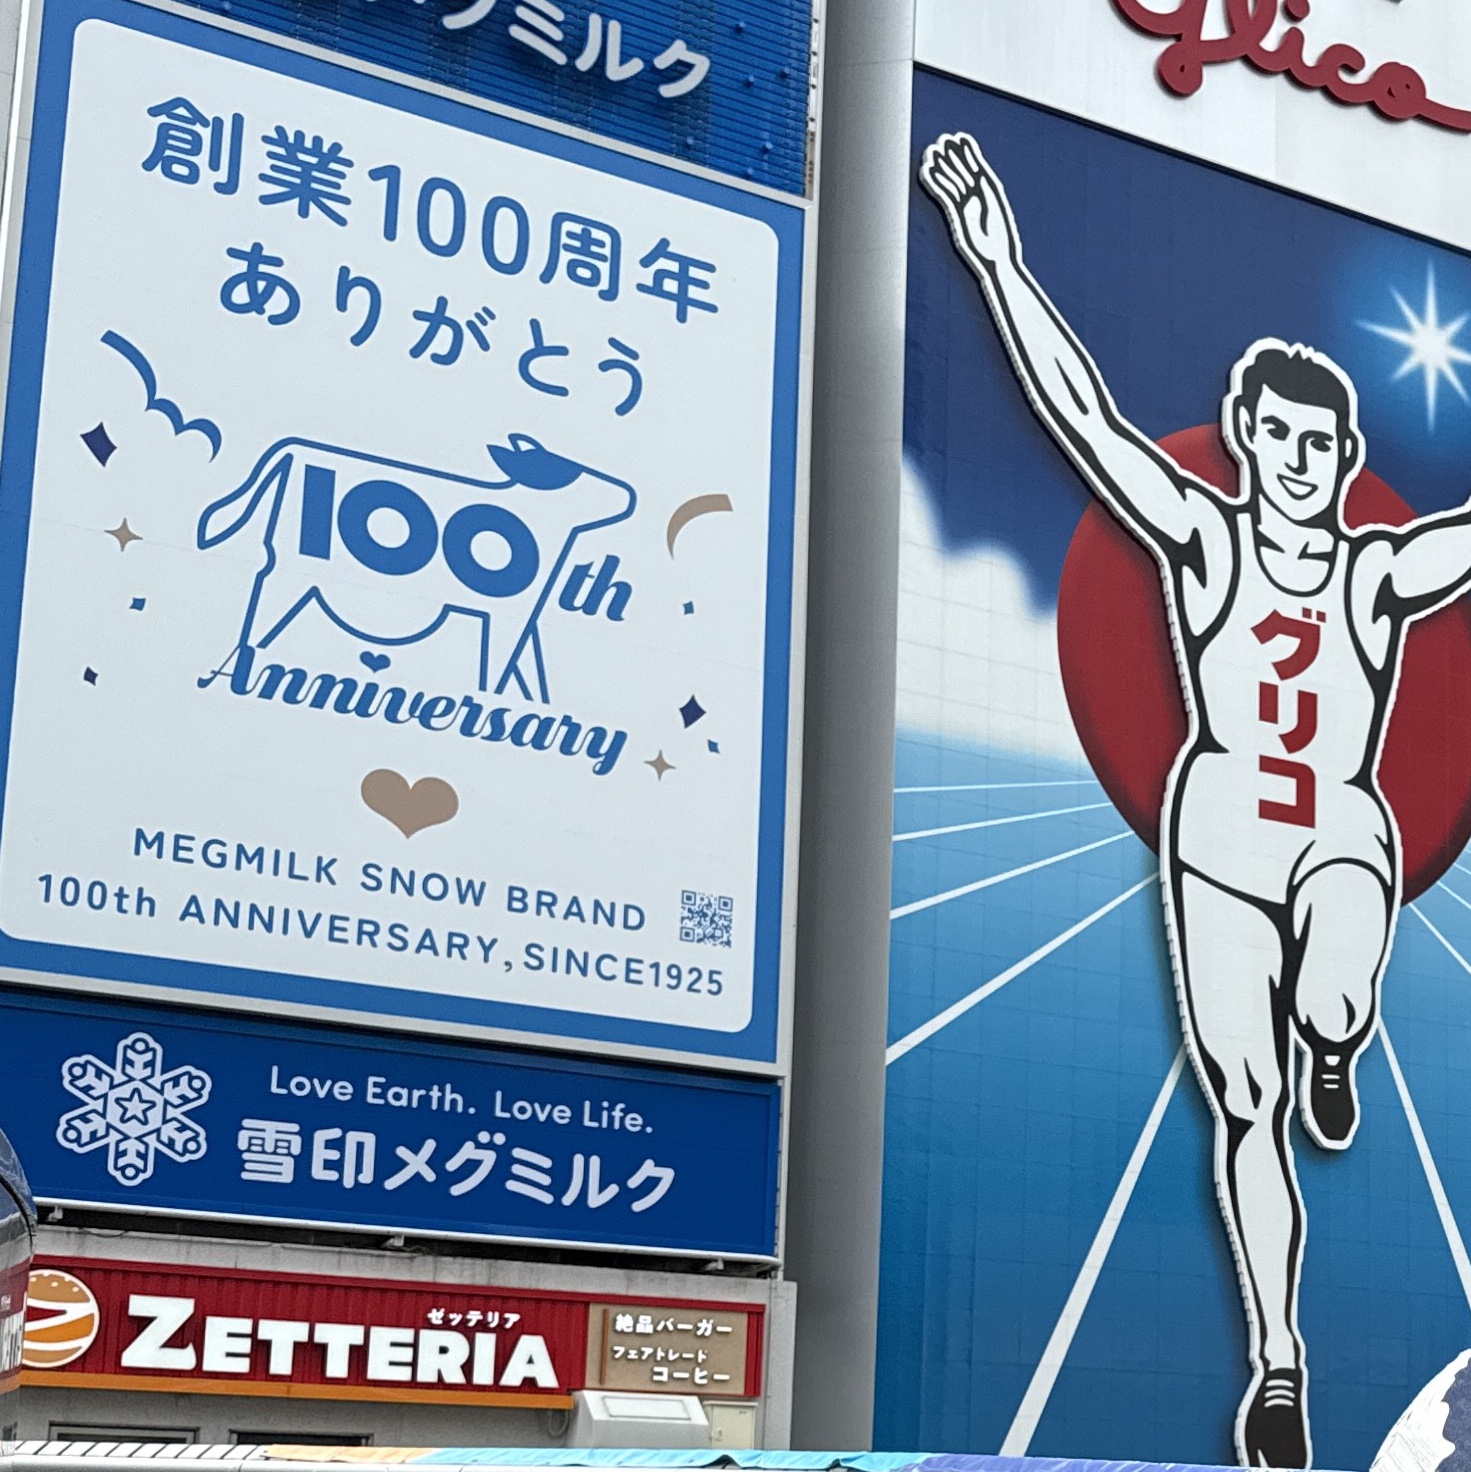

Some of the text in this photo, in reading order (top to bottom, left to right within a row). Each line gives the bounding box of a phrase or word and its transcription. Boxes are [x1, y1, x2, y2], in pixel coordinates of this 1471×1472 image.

[142, 97, 719, 324] 創業100周年
[219, 243, 643, 416] ありがとう
[298, 464, 633, 622] 100th
[197, 645, 628, 775] Anniversary
[1250, 606, 1326, 829] グリコ
[37, 874, 157, 917] 100th
[133, 827, 647, 932] MEGMILK SNOW BRAND
[270, 1066, 655, 1134] Love Earth. Love Life.
[237, 1119, 677, 1213] 雪印メグミルク
[121, 1295, 560, 1389] ZETTERIA
[426, 1306, 521, 1332] ゼッテリア
[612, 1345, 708, 1363] フェアトレード
[615, 1313, 733, 1337] 絶品バーガー
[652, 1367, 731, 1385] コーヒー
